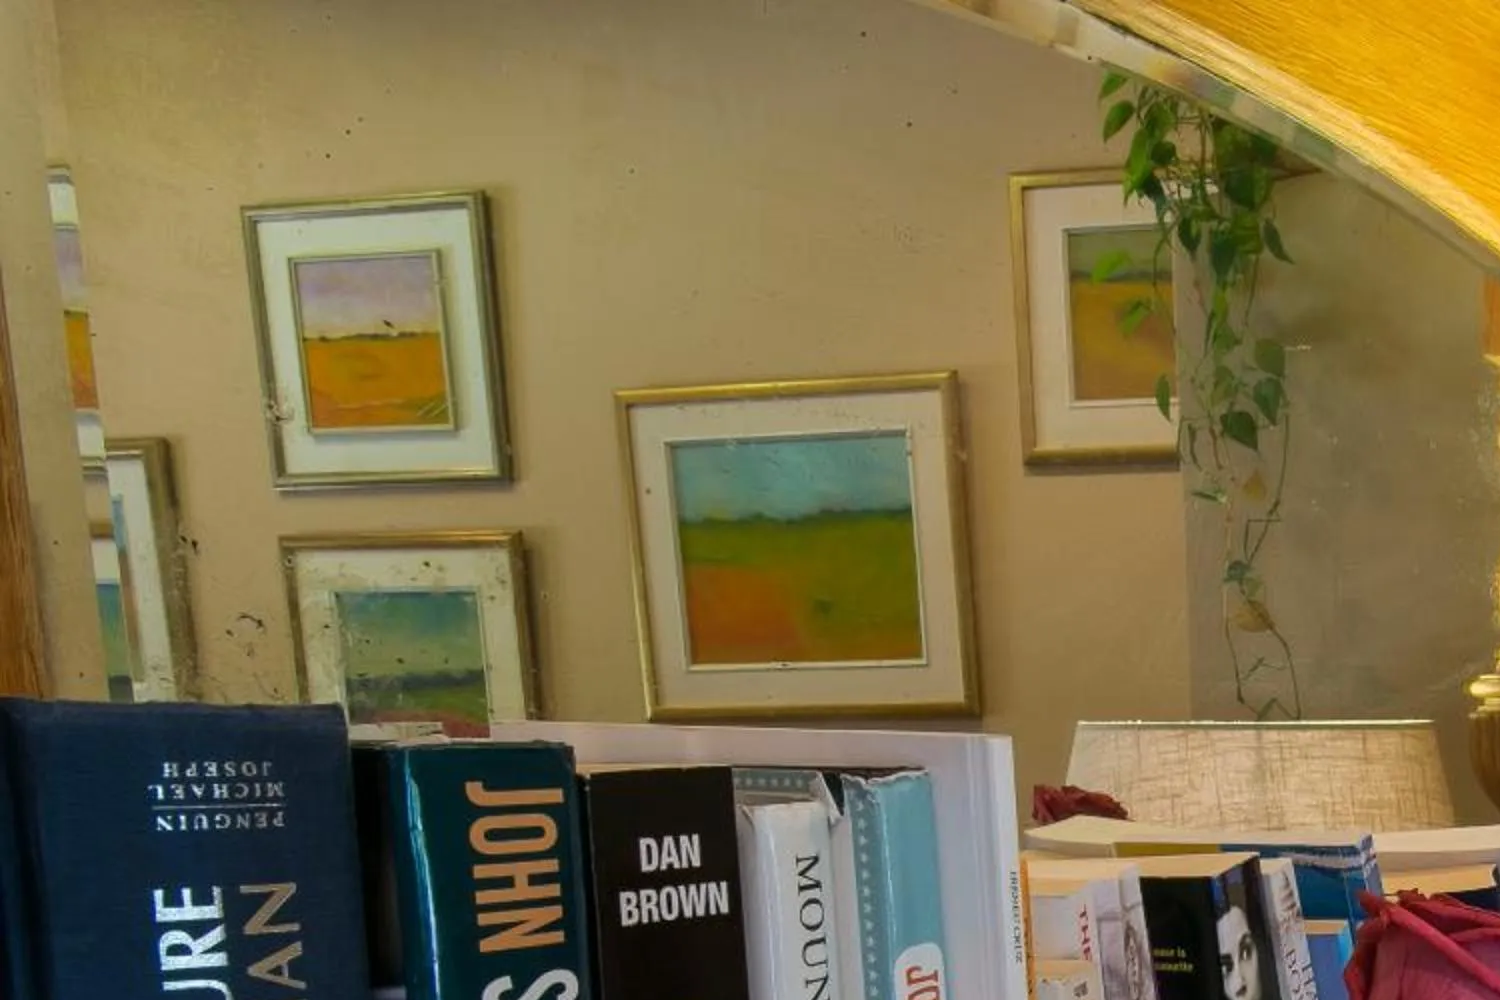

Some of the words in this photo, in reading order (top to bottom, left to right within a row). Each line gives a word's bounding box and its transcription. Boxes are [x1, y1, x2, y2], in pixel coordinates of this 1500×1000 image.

[163, 761, 273, 778] JOSEPH
[147, 781, 285, 800] MICHAEL
[156, 811, 285, 831] PENGUIN
[465, 781, 565, 953] JOHN
[638, 832, 701, 873] DAN
[618, 881, 730, 927] BROWN
